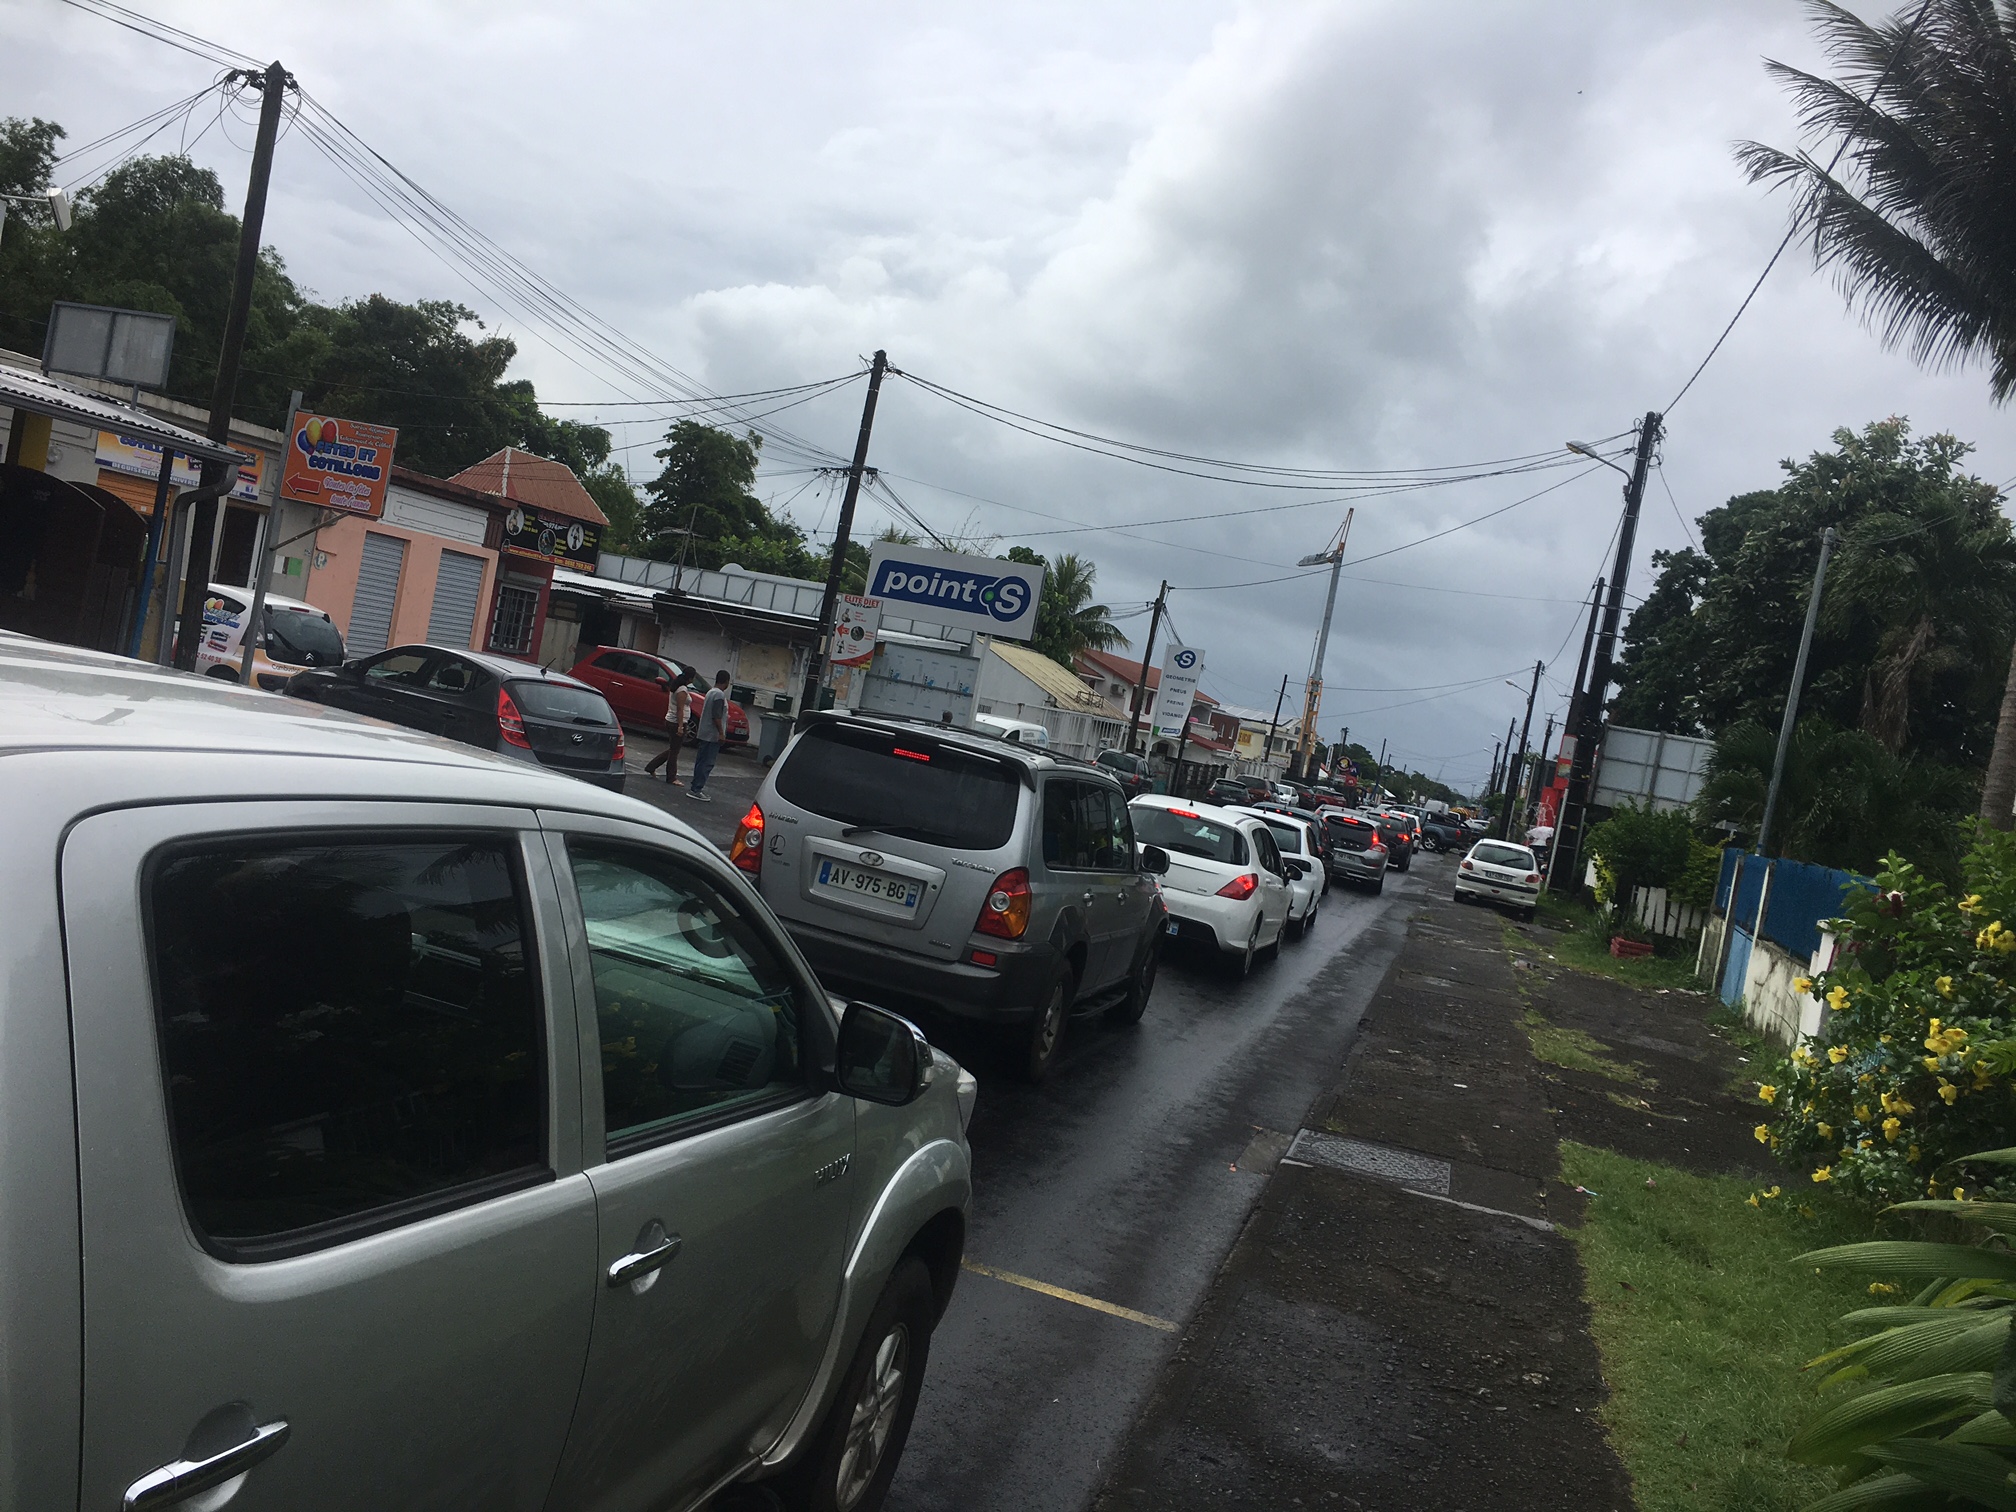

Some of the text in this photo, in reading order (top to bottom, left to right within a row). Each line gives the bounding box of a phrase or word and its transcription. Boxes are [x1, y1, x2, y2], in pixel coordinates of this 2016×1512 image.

[316, 440, 377, 462] FETES ET
[112, 462, 160, 478] DEGUISEMENT
[308, 454, 381, 481] COTILLONS
[845, 594, 880, 608] ELITE DIET
[882, 570, 1024, 614] point S
[1165, 674, 1197, 684] GEOMETRIE
[1169, 687, 1187, 695] PNEUS
[831, 867, 906, 900] AV-975-BG
